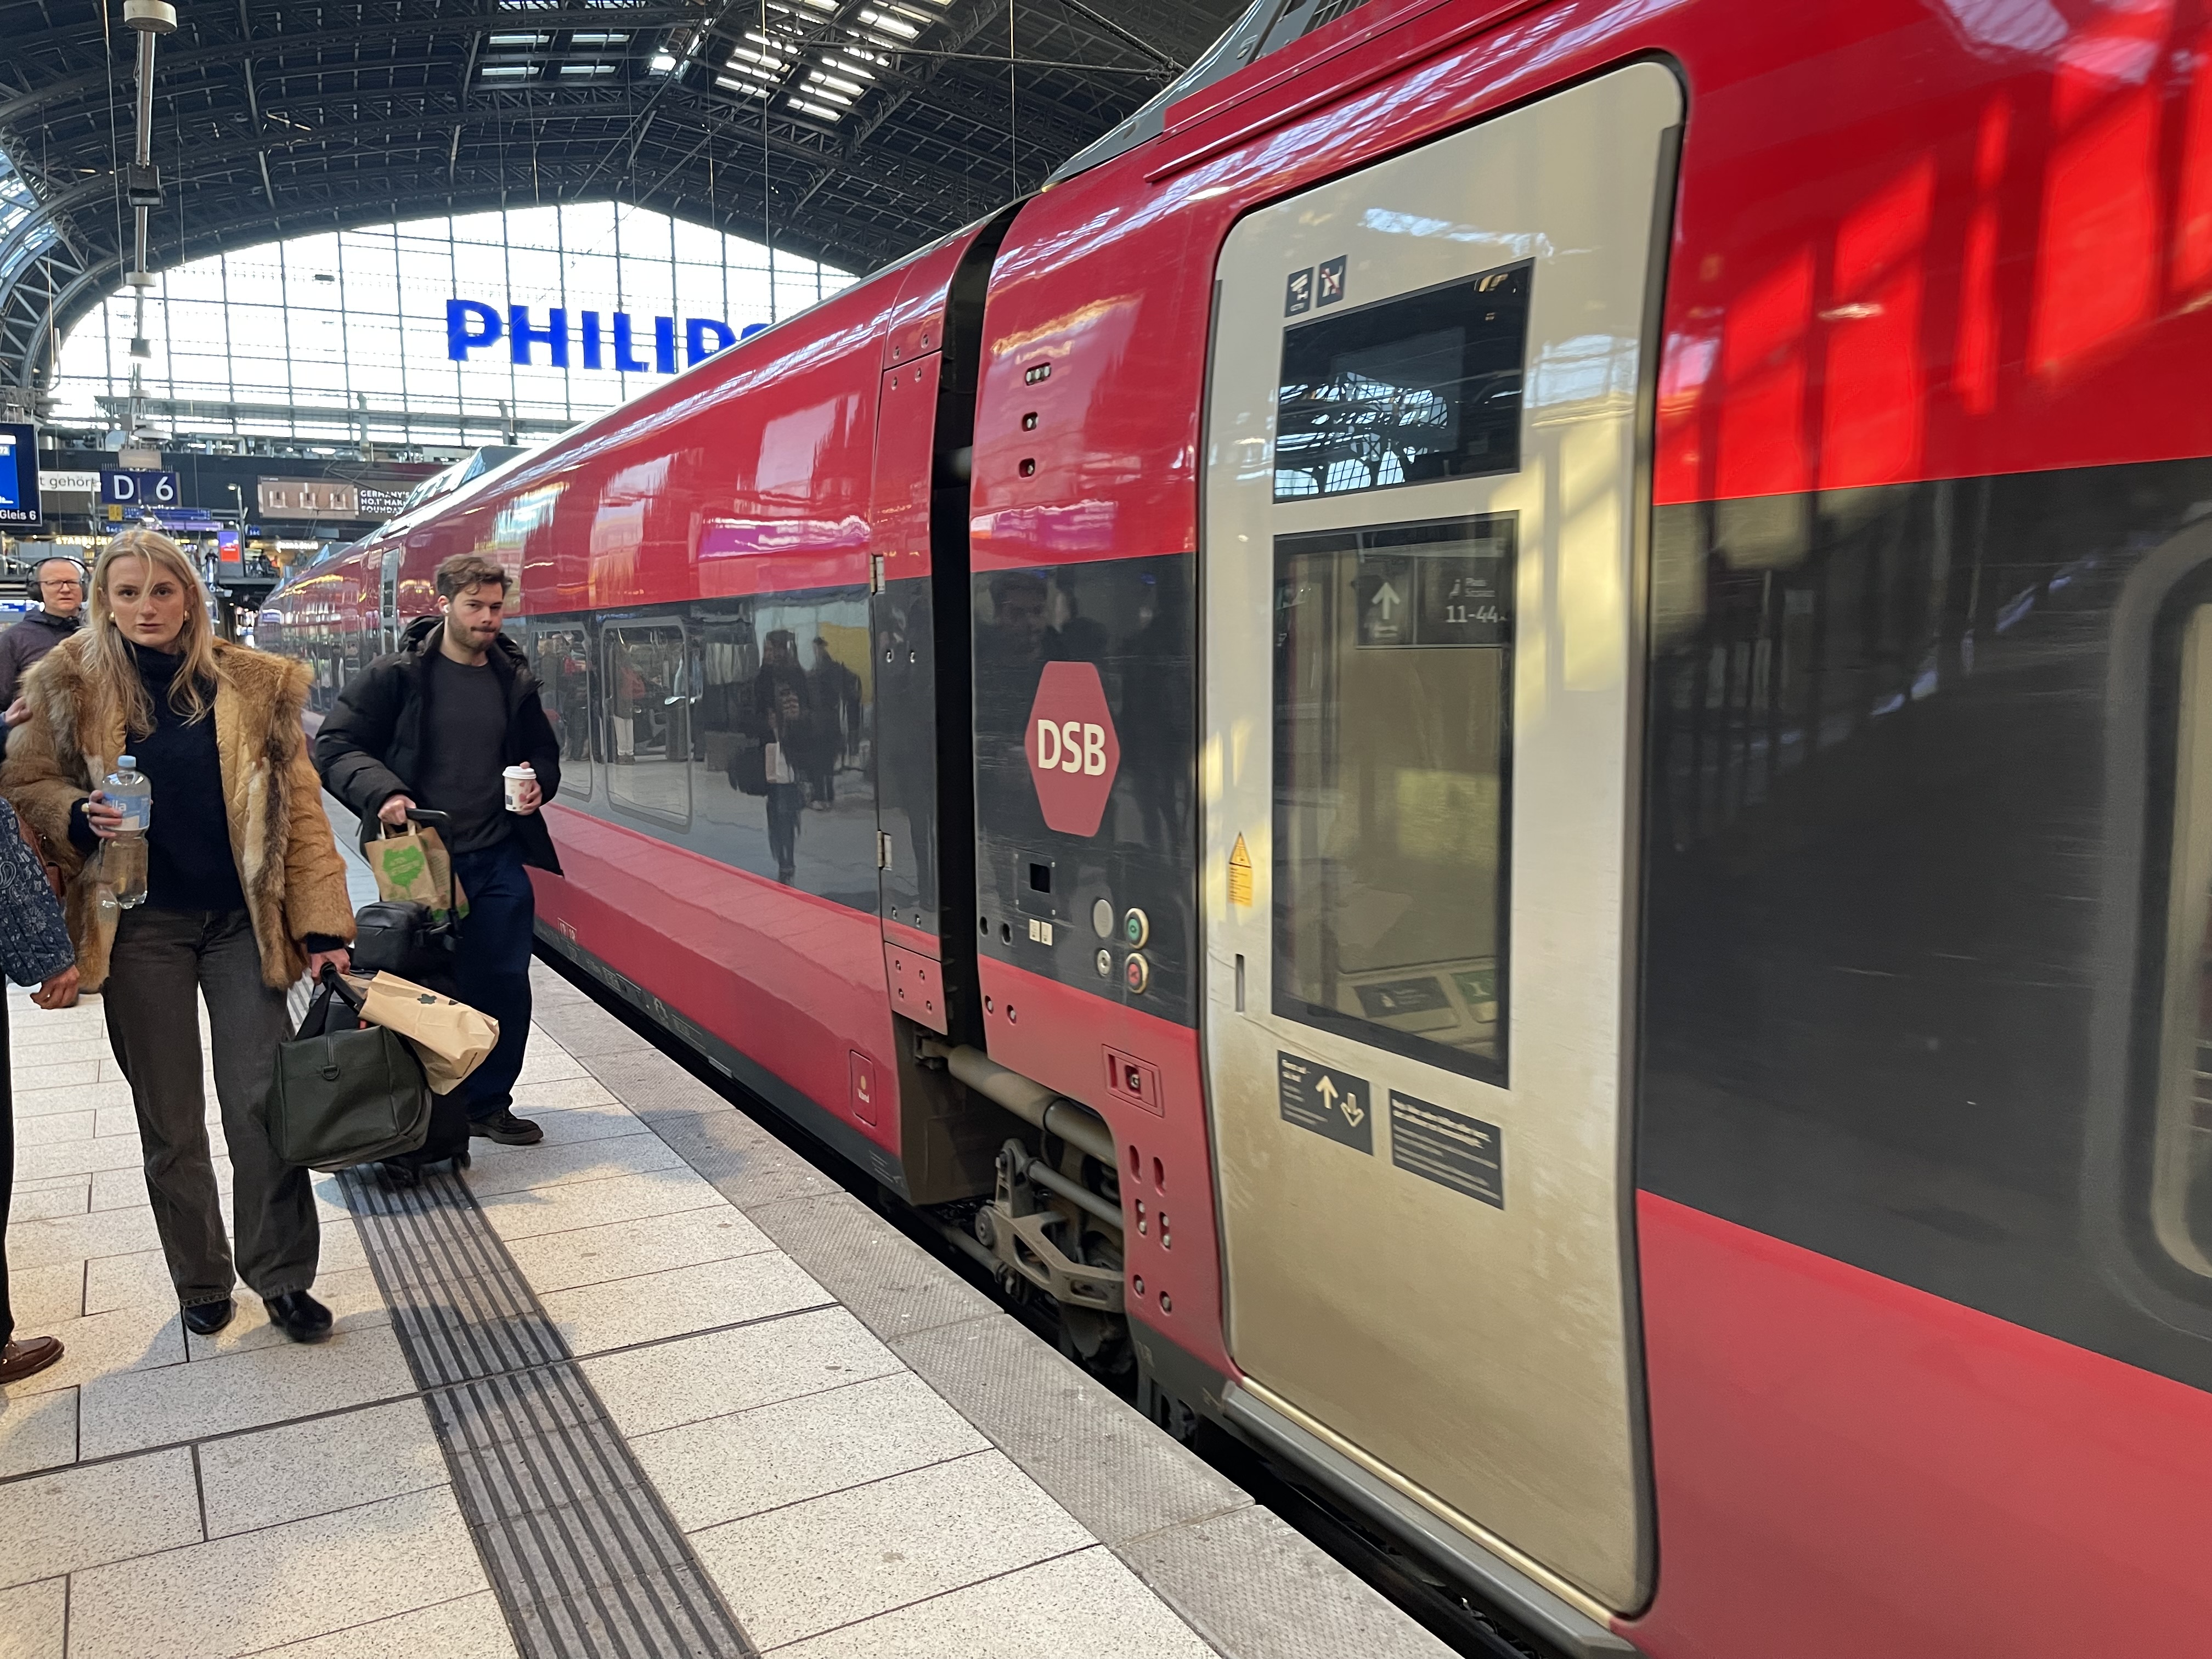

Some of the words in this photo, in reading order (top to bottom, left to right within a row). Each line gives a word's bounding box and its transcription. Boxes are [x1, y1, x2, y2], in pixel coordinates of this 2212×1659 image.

[113, 475, 134, 500] D
[156, 476, 174, 501] 6
[0, 509, 27, 520] Gleis
[29, 510, 37, 521] 6
[1445, 605, 1498, 623] 11-44
[1037, 719, 1107, 776] DSB
